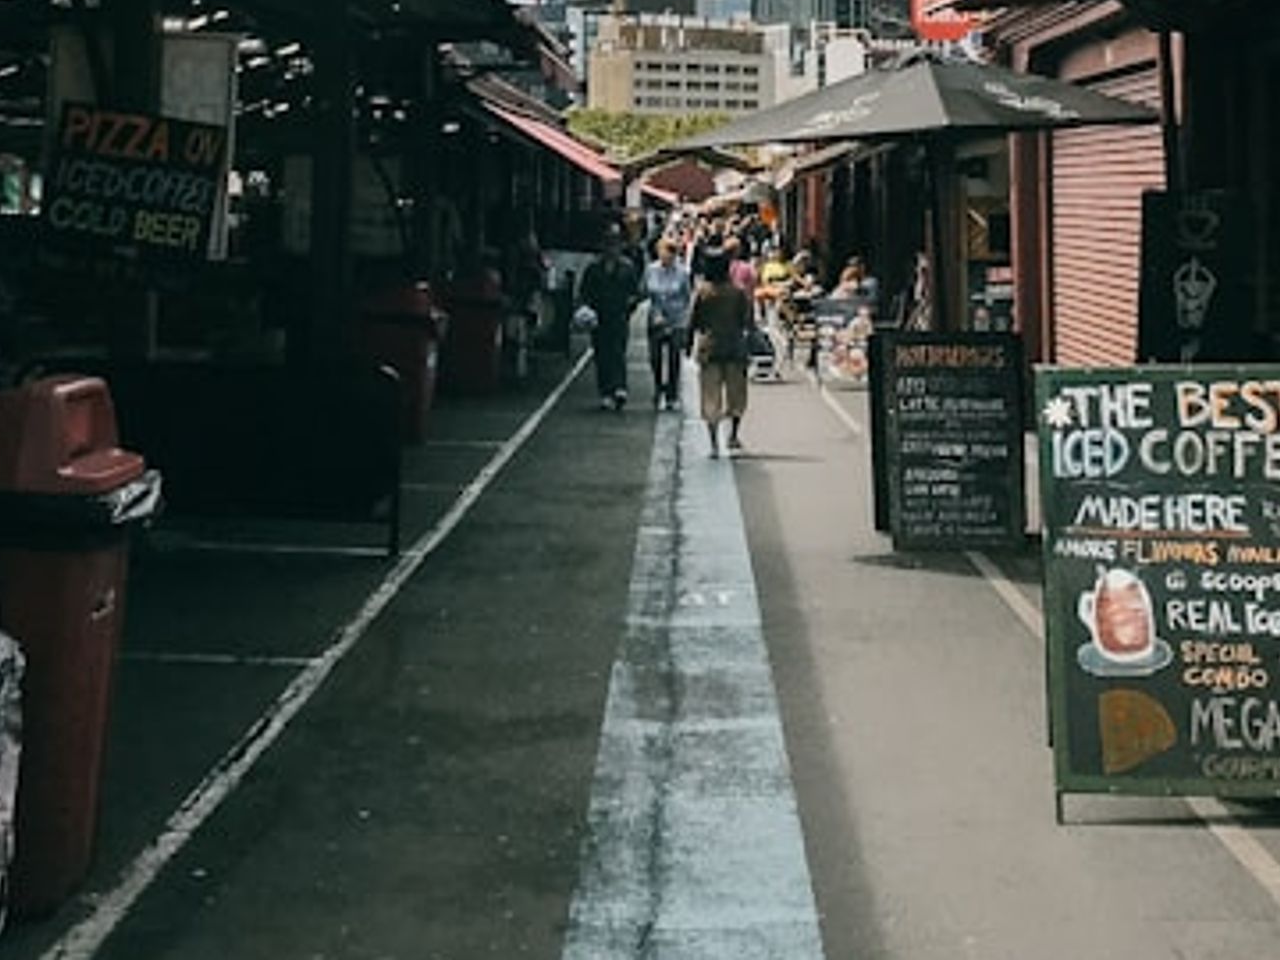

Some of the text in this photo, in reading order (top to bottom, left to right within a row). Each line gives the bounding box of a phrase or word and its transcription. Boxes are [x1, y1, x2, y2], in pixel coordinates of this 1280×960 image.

[63, 106, 170, 161] PIZZA
[57, 156, 124, 198] ICED
[49, 195, 201, 250] COLD BEER
[1061, 382, 1154, 429] THE
[1052, 430, 1131, 479] ICED
[1075, 494, 1249, 532] MADE HERE
[1165, 599, 1242, 634] REAL
[1183, 665, 1269, 691] COMBO
